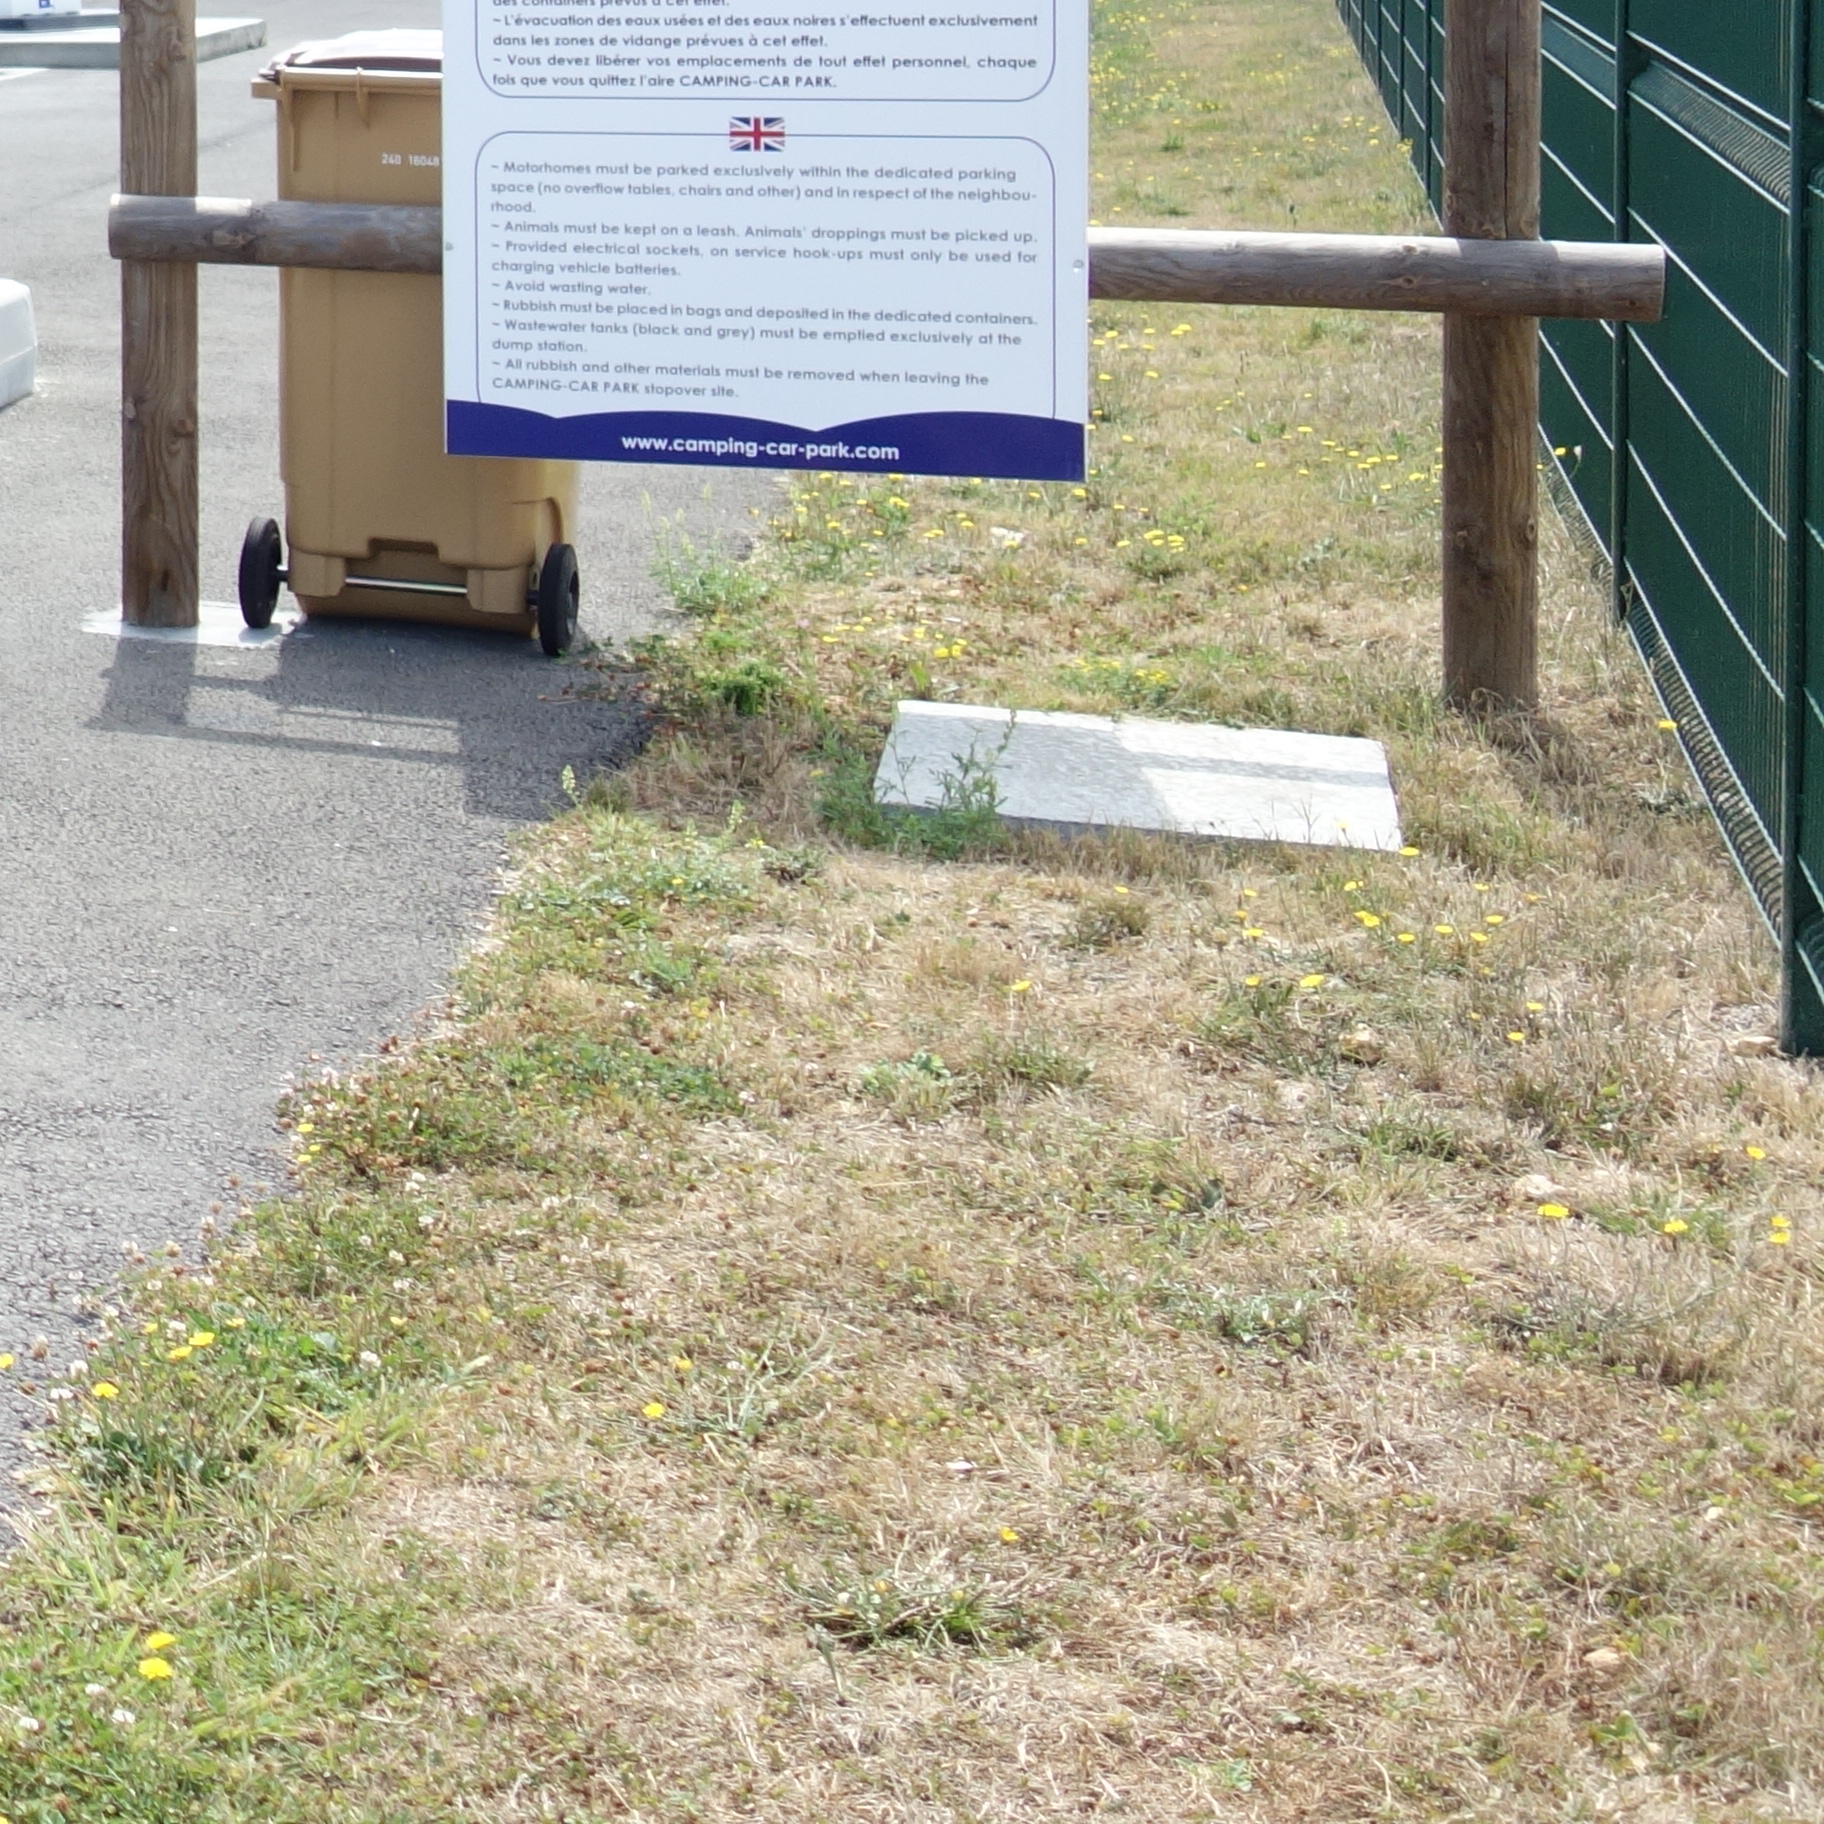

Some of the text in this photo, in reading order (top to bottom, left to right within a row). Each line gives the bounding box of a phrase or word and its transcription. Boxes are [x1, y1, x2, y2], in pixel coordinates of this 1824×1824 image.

[504, 13, 1038, 26] L'évacuation des eaux usées et des eaux noires s'effectuent exclusivement
[492, 34, 526, 46] dans
[530, 34, 550, 46] les
[554, 36, 594, 46] zones
[599, 34, 618, 46] de
[622, 34, 681, 49] vidange
[686, 33, 744, 49] prévues
[748, 33, 758, 46] à
[762, 34, 786, 46] cet
[507, 54, 541, 66] Vous
[547, 54, 590, 66] devez
[595, 53, 641, 66] libérer
[646, 57, 670, 66] vos
[676, 54, 786, 69] emplacements
[793, 55, 812, 67] de
[818, 55, 846, 67] tout
[852, 55, 885, 67] effet
[976, 55, 1037, 70] chaque
[492, 73, 516, 87] fois
[520, 76, 547, 87] que
[552, 76, 584, 86] vous
[588, 74, 635, 89] quittez
[639, 74, 674, 86] l'aire
[679, 74, 789, 87] CAMPING-CAR
[491, 337, 533, 353] dump
[492, 376, 598, 392] CAMPING-CAR
[603, 381, 639, 394] PARK
[644, 382, 706, 399] stopover
[621, 432, 899, 464] www.camping-car-park.com
